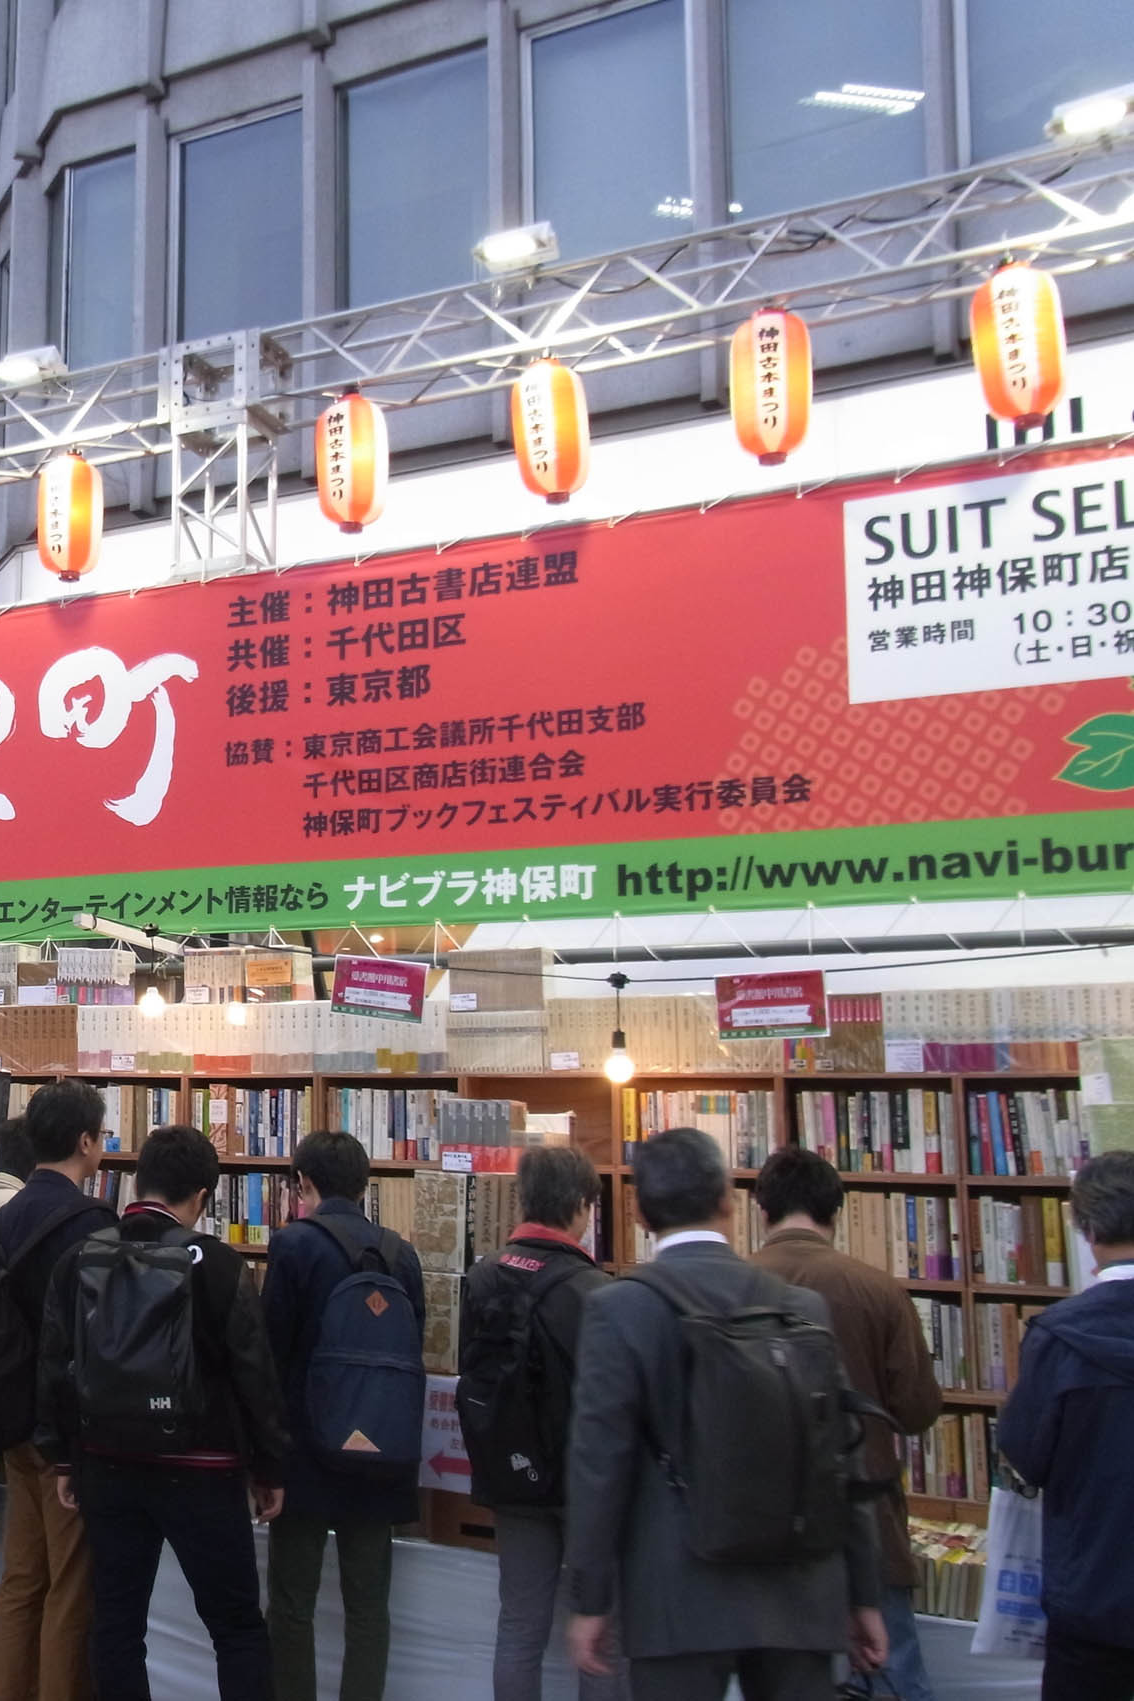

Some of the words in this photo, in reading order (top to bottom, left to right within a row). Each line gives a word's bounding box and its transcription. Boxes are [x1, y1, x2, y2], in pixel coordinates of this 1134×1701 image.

[994, 285, 1029, 393] 神田古本まつり
[757, 326, 782, 431] 神田古本まつり
[326, 412, 346, 501] 神田古本まつり
[864, 497, 1008, 566] SUIT
[1031, 479, 1134, 543] SEL
[867, 544, 1130, 613] 神田神保町店
[867, 617, 976, 653] 営業時間
[302, 748, 586, 800] 千代田区商店街連合会
[302, 772, 812, 840] 神保町ブックフェスティバル実行委員会
[343, 862, 598, 913] ナビブラ神保町
[616, 838, 1134, 902] http://www.navi-bur
[149, 1397, 171, 1409] HH
